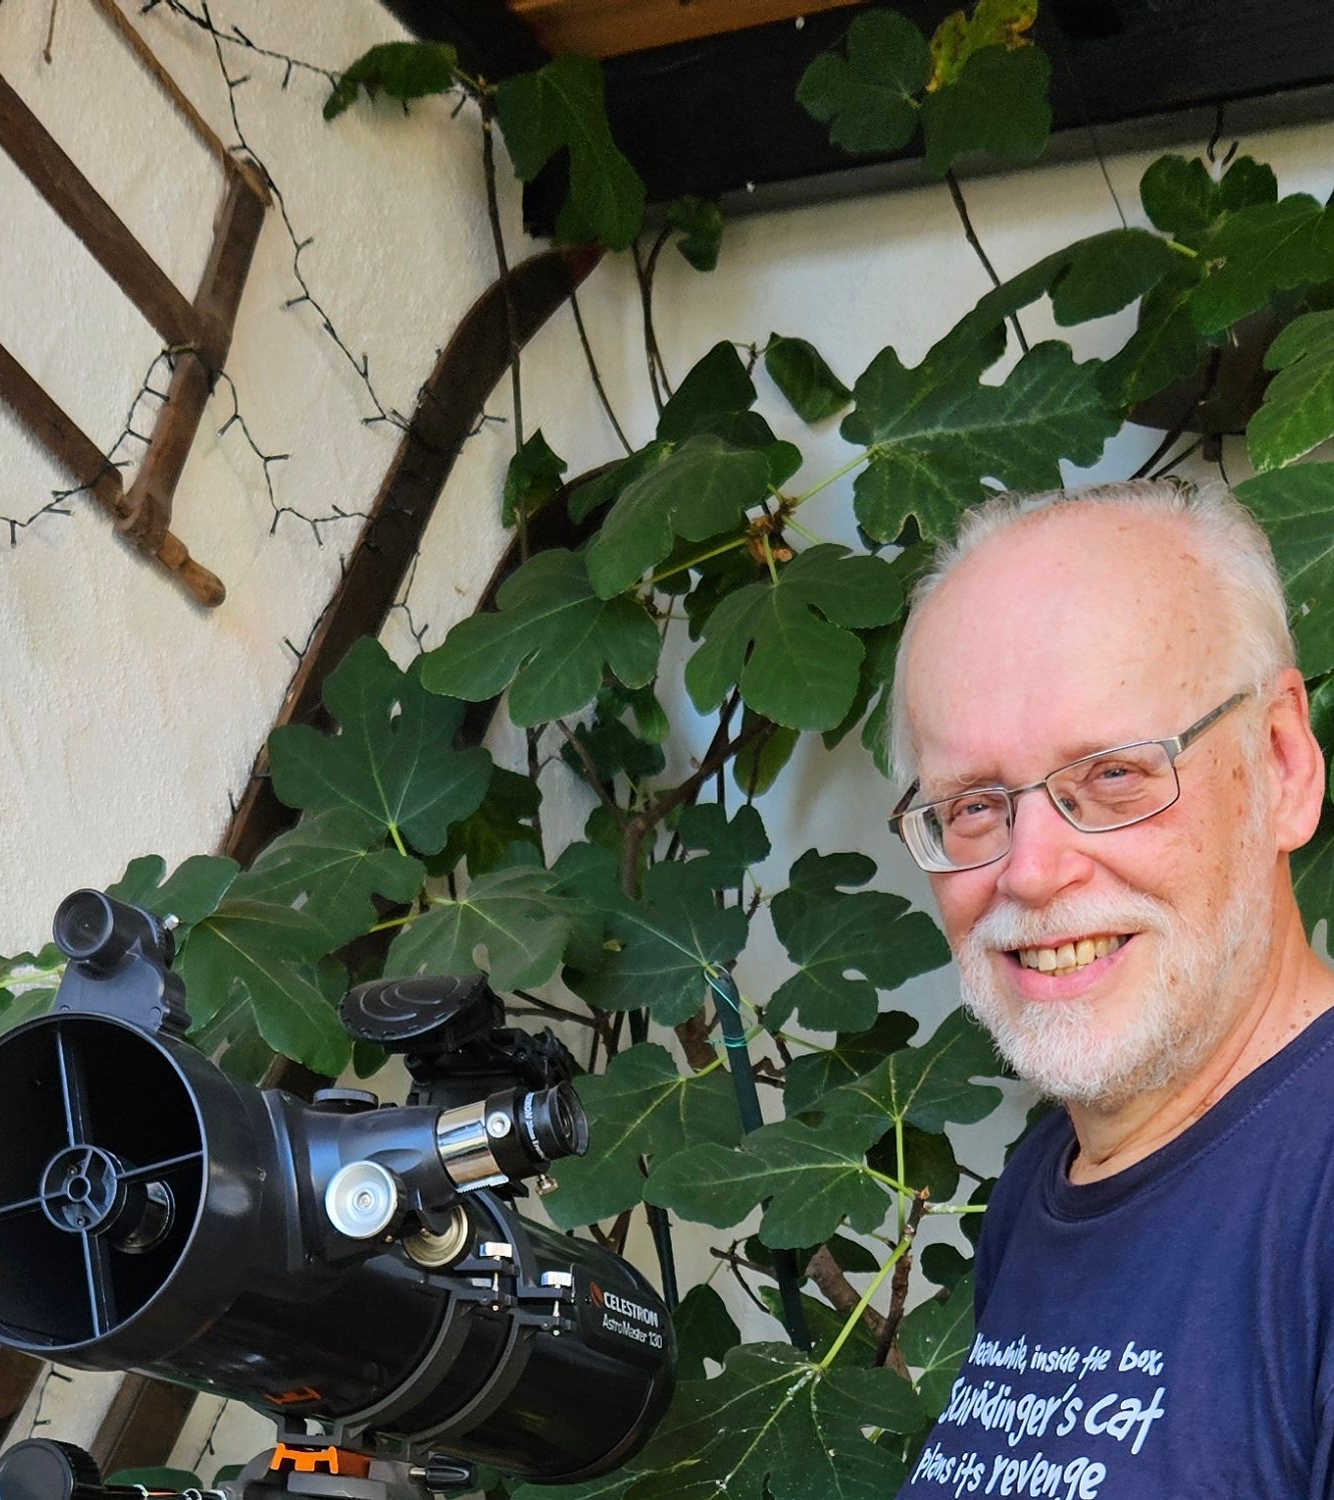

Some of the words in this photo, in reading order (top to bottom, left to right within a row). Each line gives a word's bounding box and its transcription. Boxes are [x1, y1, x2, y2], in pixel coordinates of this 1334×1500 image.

[603, 1291, 659, 1328] CELESTRON
[602, 1313, 648, 1343] AstroMaster
[648, 1331, 663, 1349] 130
[1030, 1345, 1080, 1373] inside
[1078, 1346, 1112, 1380] the
[1119, 1341, 1164, 1376] box,
[938, 1376, 1084, 1447] Schrödinger's
[1084, 1387, 1165, 1455] cat
[911, 1442, 956, 1484] plans
[953, 1452, 986, 1499] its
